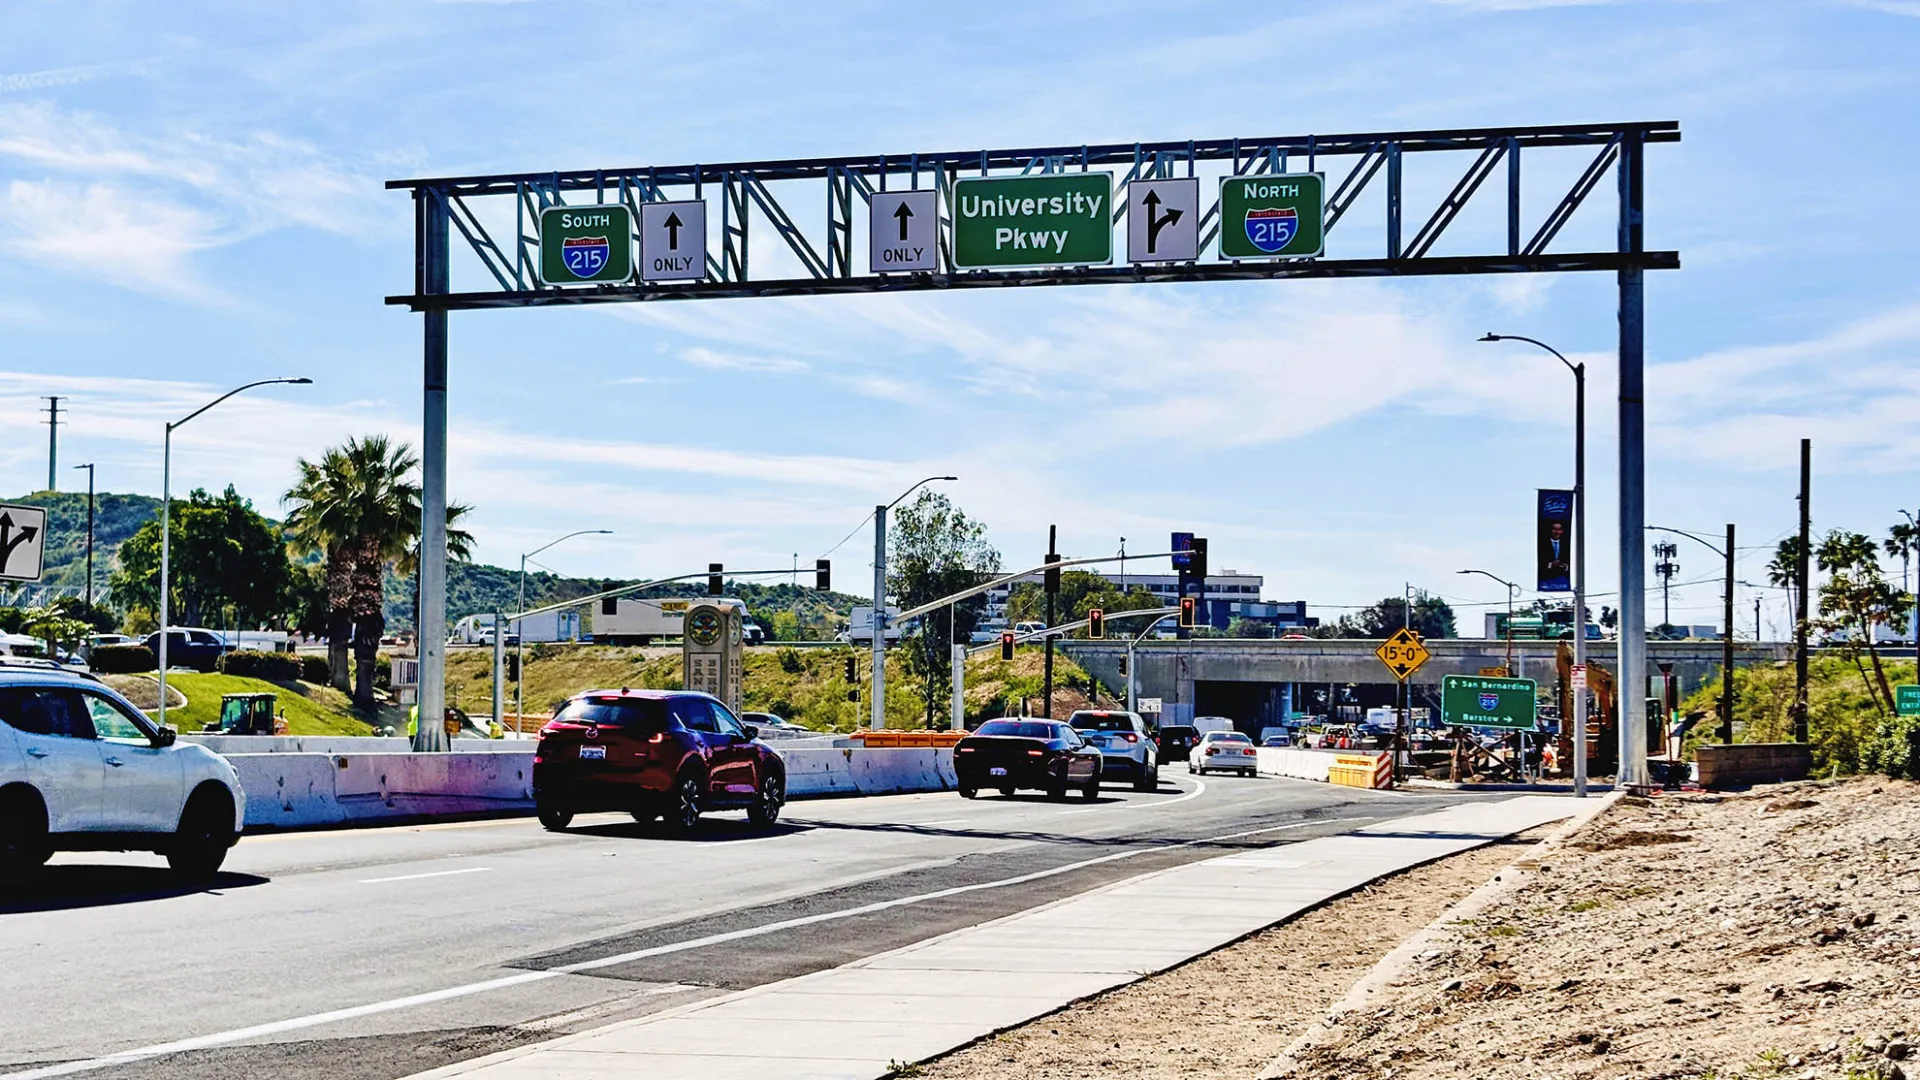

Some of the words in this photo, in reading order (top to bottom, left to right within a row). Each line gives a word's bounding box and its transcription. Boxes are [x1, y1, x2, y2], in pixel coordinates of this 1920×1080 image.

[1244, 183, 1299, 199] NORTH
[961, 191, 1103, 218] University
[561, 213, 610, 228] SOUTH
[1254, 222, 1289, 242] 215
[995, 227, 1069, 254] Pkwy
[570, 250, 601, 269] 215
[883, 248, 924, 262] ONLY
[653, 257, 694, 272] ONLY
[1481, 681, 1530, 691] Bernardino
[1482, 699, 1497, 707] 215
[1462, 713, 1499, 722] Barstow
